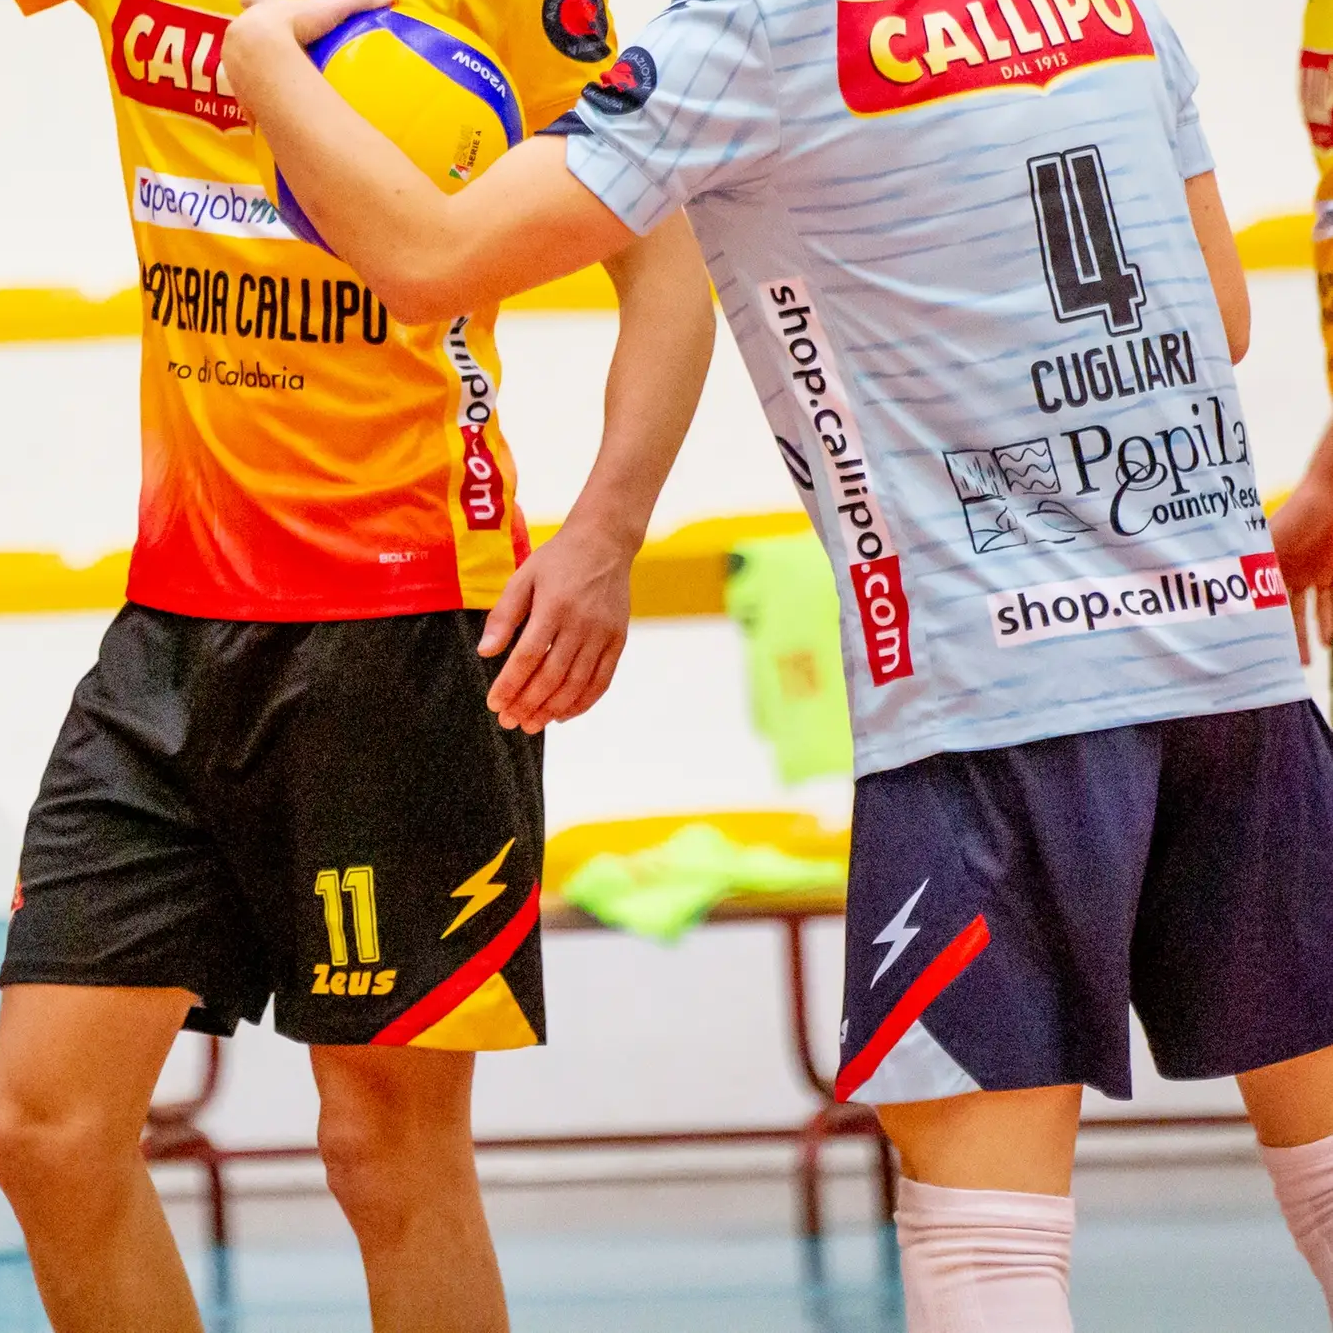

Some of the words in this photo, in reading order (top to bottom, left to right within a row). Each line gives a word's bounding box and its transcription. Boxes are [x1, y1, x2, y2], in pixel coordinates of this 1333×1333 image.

[452, 50, 507, 98] V200W
[1000, 58, 1033, 80] DAL
[1034, 51, 1069, 75] 1913
[194, 98, 218, 116] DAL
[223, 103, 248, 121] 191
[1026, 144, 1147, 337] 4
[236, 272, 387, 346] CALLIPO
[215, 359, 305, 391] Calabria
[1030, 329, 1197, 414] CUGLIARI
[769, 284, 902, 675] shop.callipo.com
[314, 866, 380, 967] 11
[311, 964, 397, 996] Zeus
